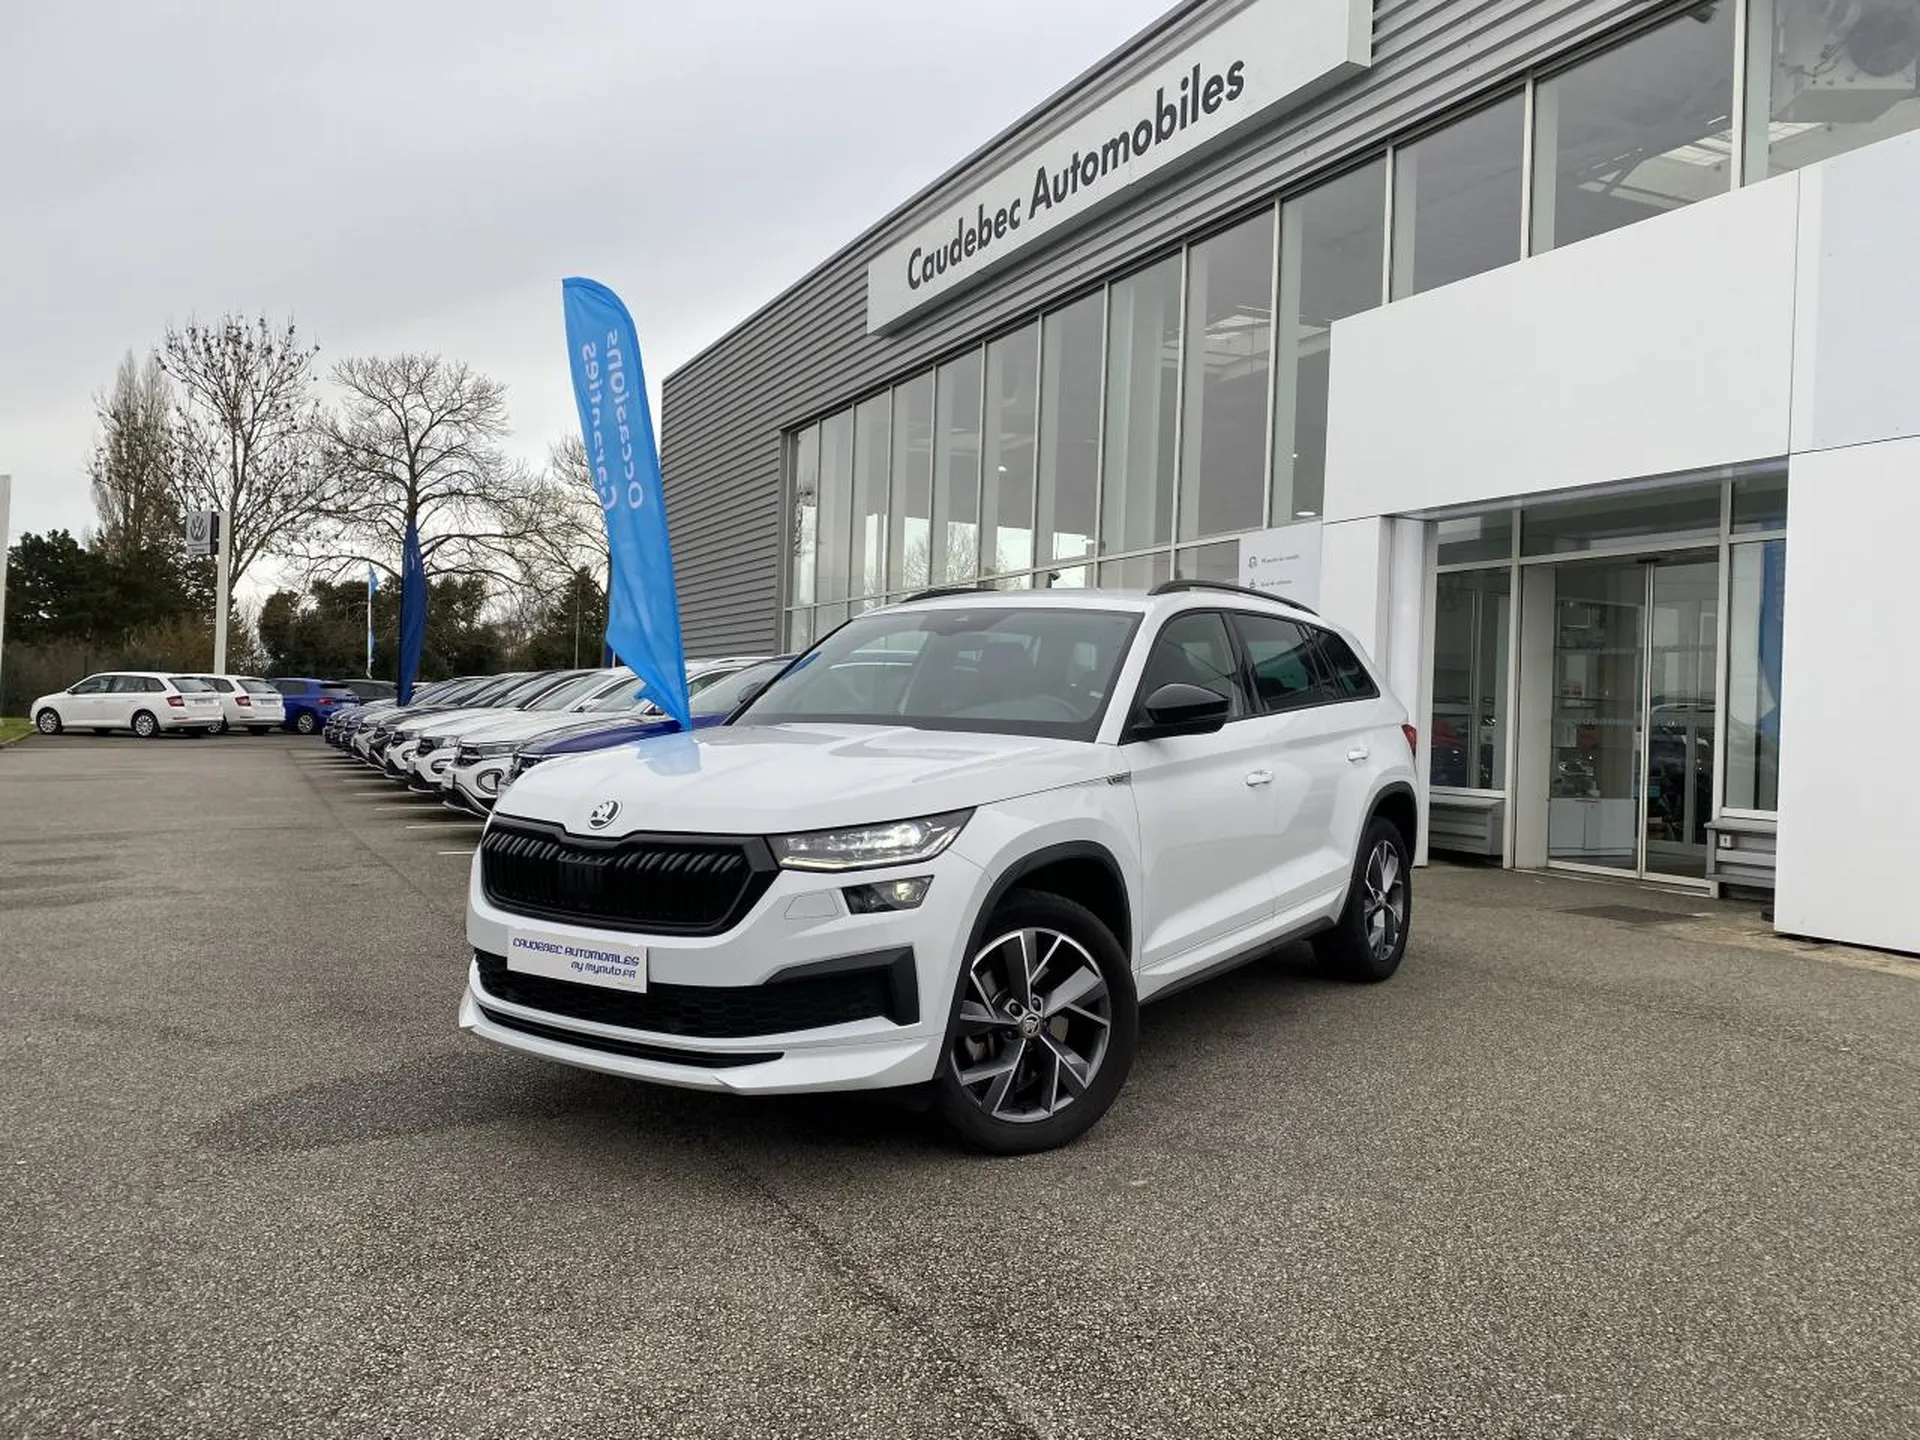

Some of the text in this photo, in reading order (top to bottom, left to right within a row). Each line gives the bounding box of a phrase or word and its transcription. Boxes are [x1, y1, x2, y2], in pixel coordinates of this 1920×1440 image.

[907, 60, 1245, 289] Caudebec Automobiles
[513, 938, 639, 966] CAUDEBEC AUTOMOBILES
